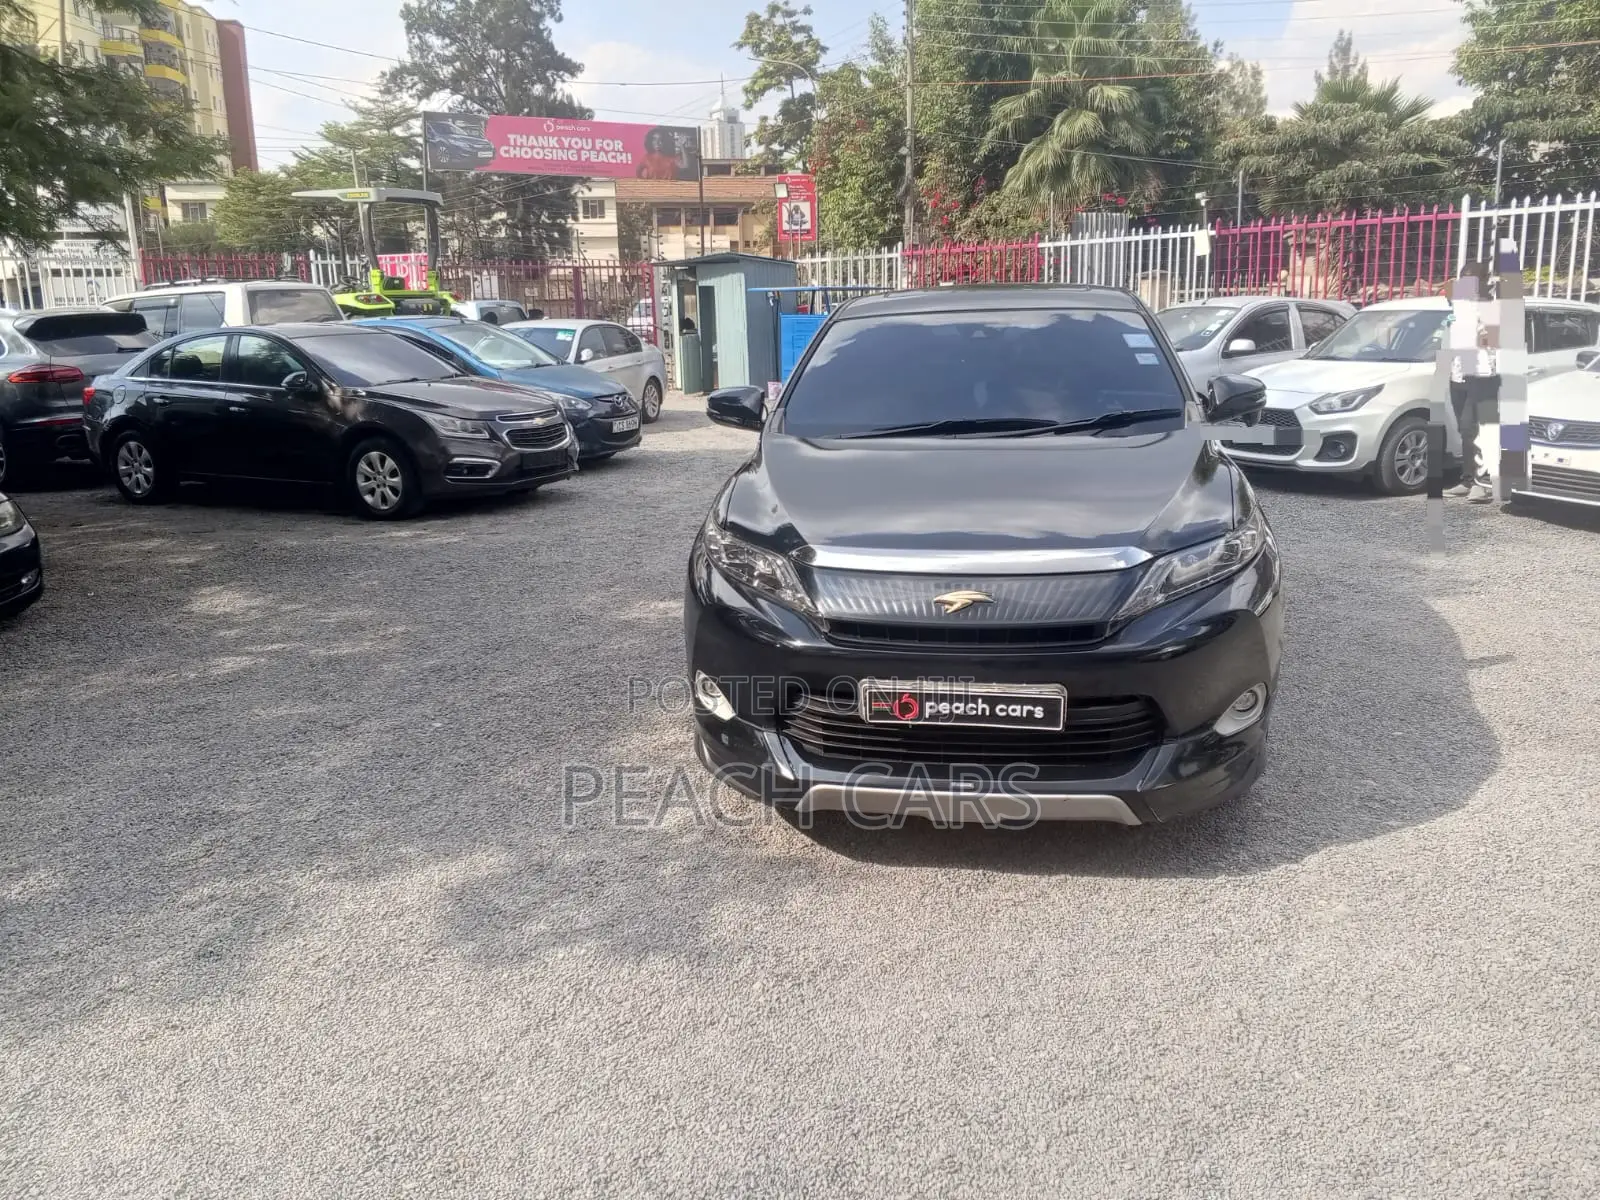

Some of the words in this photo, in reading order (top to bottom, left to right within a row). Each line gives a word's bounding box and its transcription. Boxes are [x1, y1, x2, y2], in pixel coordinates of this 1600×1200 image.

[507, 134, 559, 148] THANK
[561, 137, 592, 150] YOU
[595, 139, 623, 152] FOR
[499, 146, 578, 161] CHOOSING
[581, 150, 632, 164] PEACH!
[925, 697, 990, 719] peach
[995, 701, 1045, 719] cars
